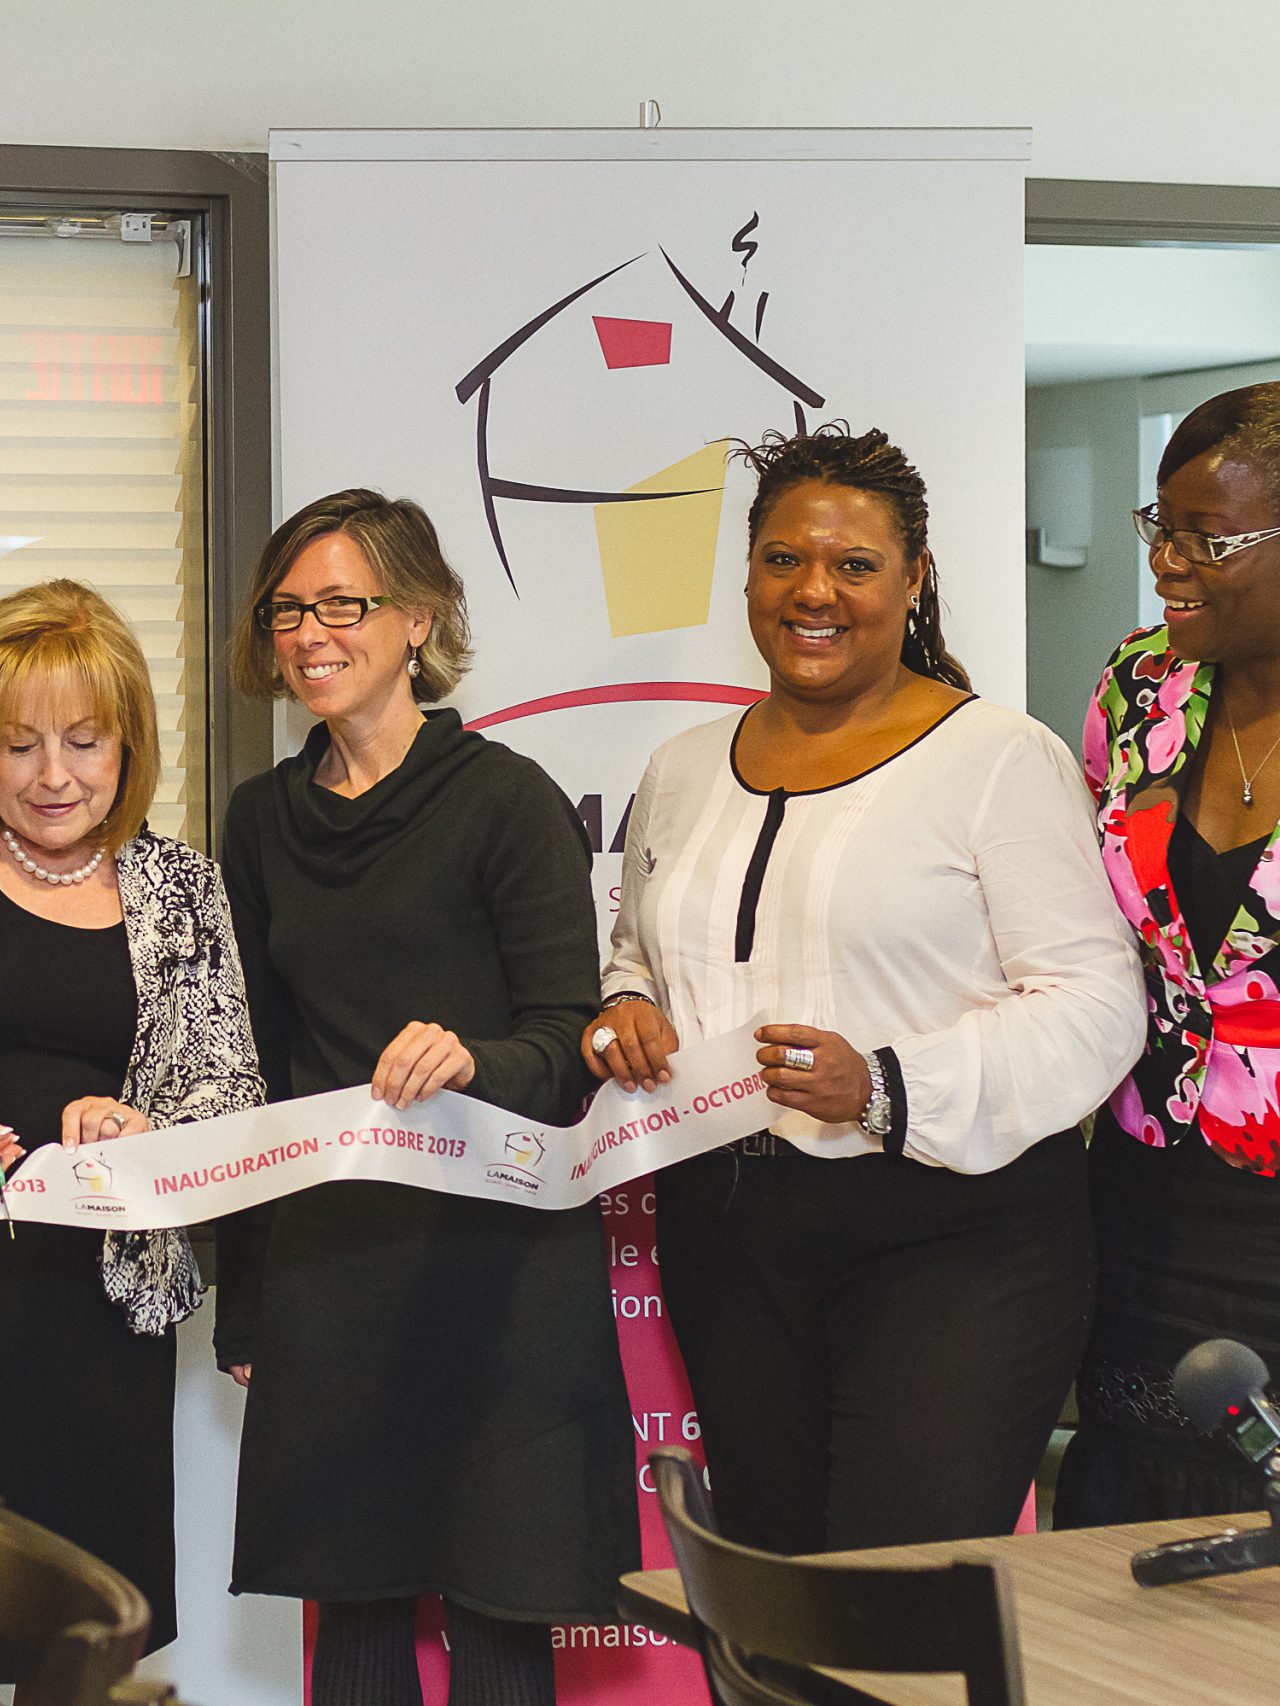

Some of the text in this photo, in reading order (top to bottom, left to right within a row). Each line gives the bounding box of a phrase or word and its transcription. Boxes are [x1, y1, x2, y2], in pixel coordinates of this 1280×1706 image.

[154, 1137, 320, 1196] INAUGURATION
[338, 1127, 424, 1151] OCTOBRE
[427, 1131, 467, 1158] 2013
[571, 1106, 680, 1180] INAUGURATION
